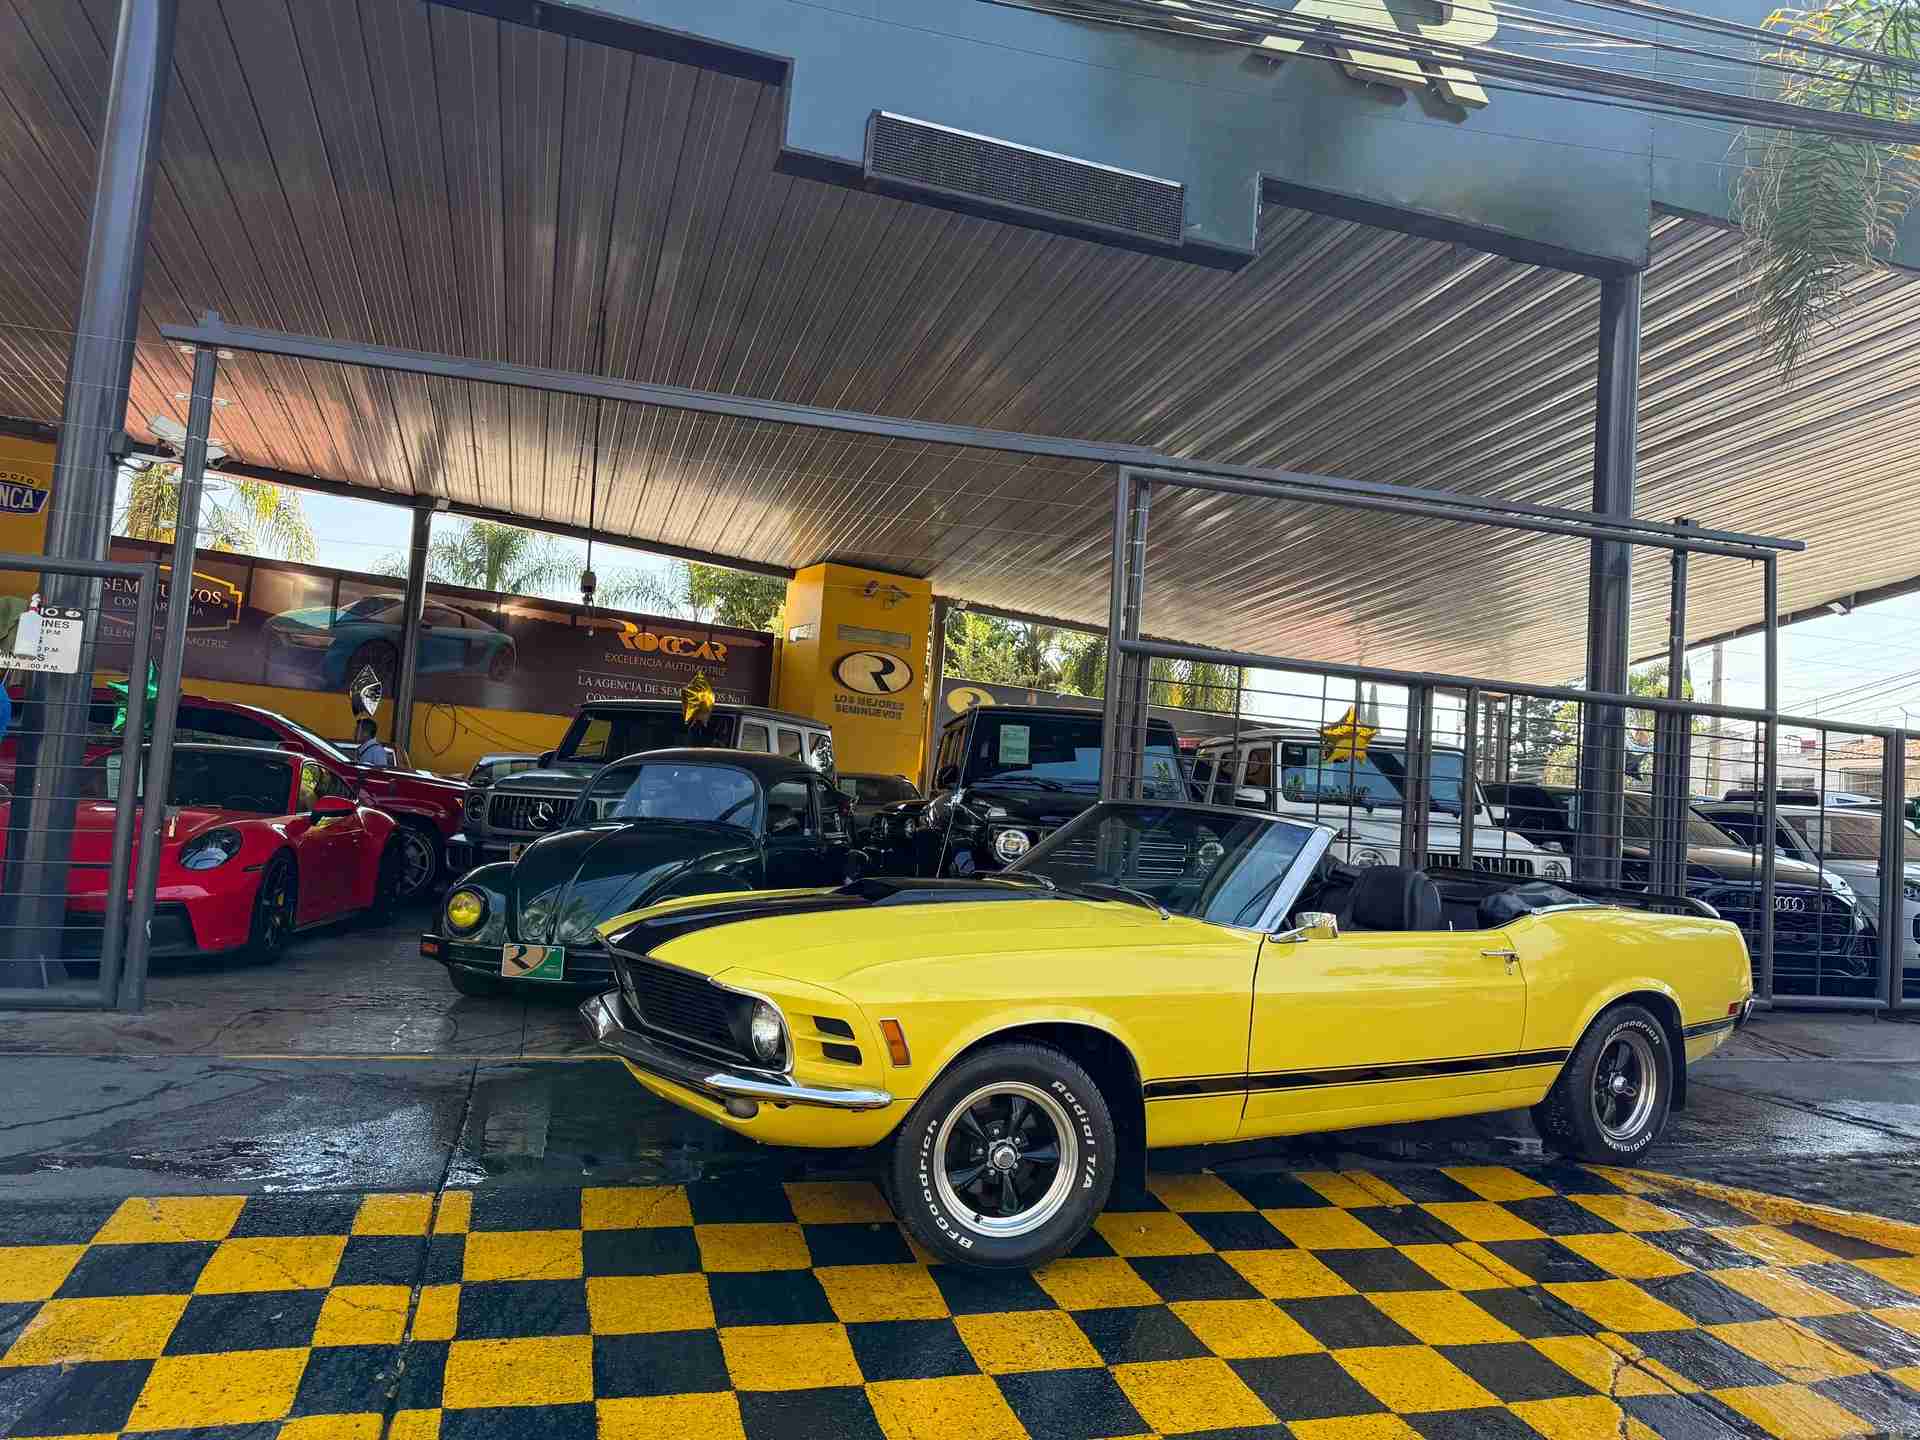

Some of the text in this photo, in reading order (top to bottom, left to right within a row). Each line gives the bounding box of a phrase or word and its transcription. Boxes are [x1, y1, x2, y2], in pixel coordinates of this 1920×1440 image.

[578, 675, 592, 687] LA
[593, 678, 642, 694] AGENCIA
[834, 693, 905, 711] LOS MEJORES
[834, 703, 903, 721] SEMINUEVOS
[1051, 1079, 1097, 1190] Radial T/A
[918, 1118, 975, 1250] BFGoodrich
